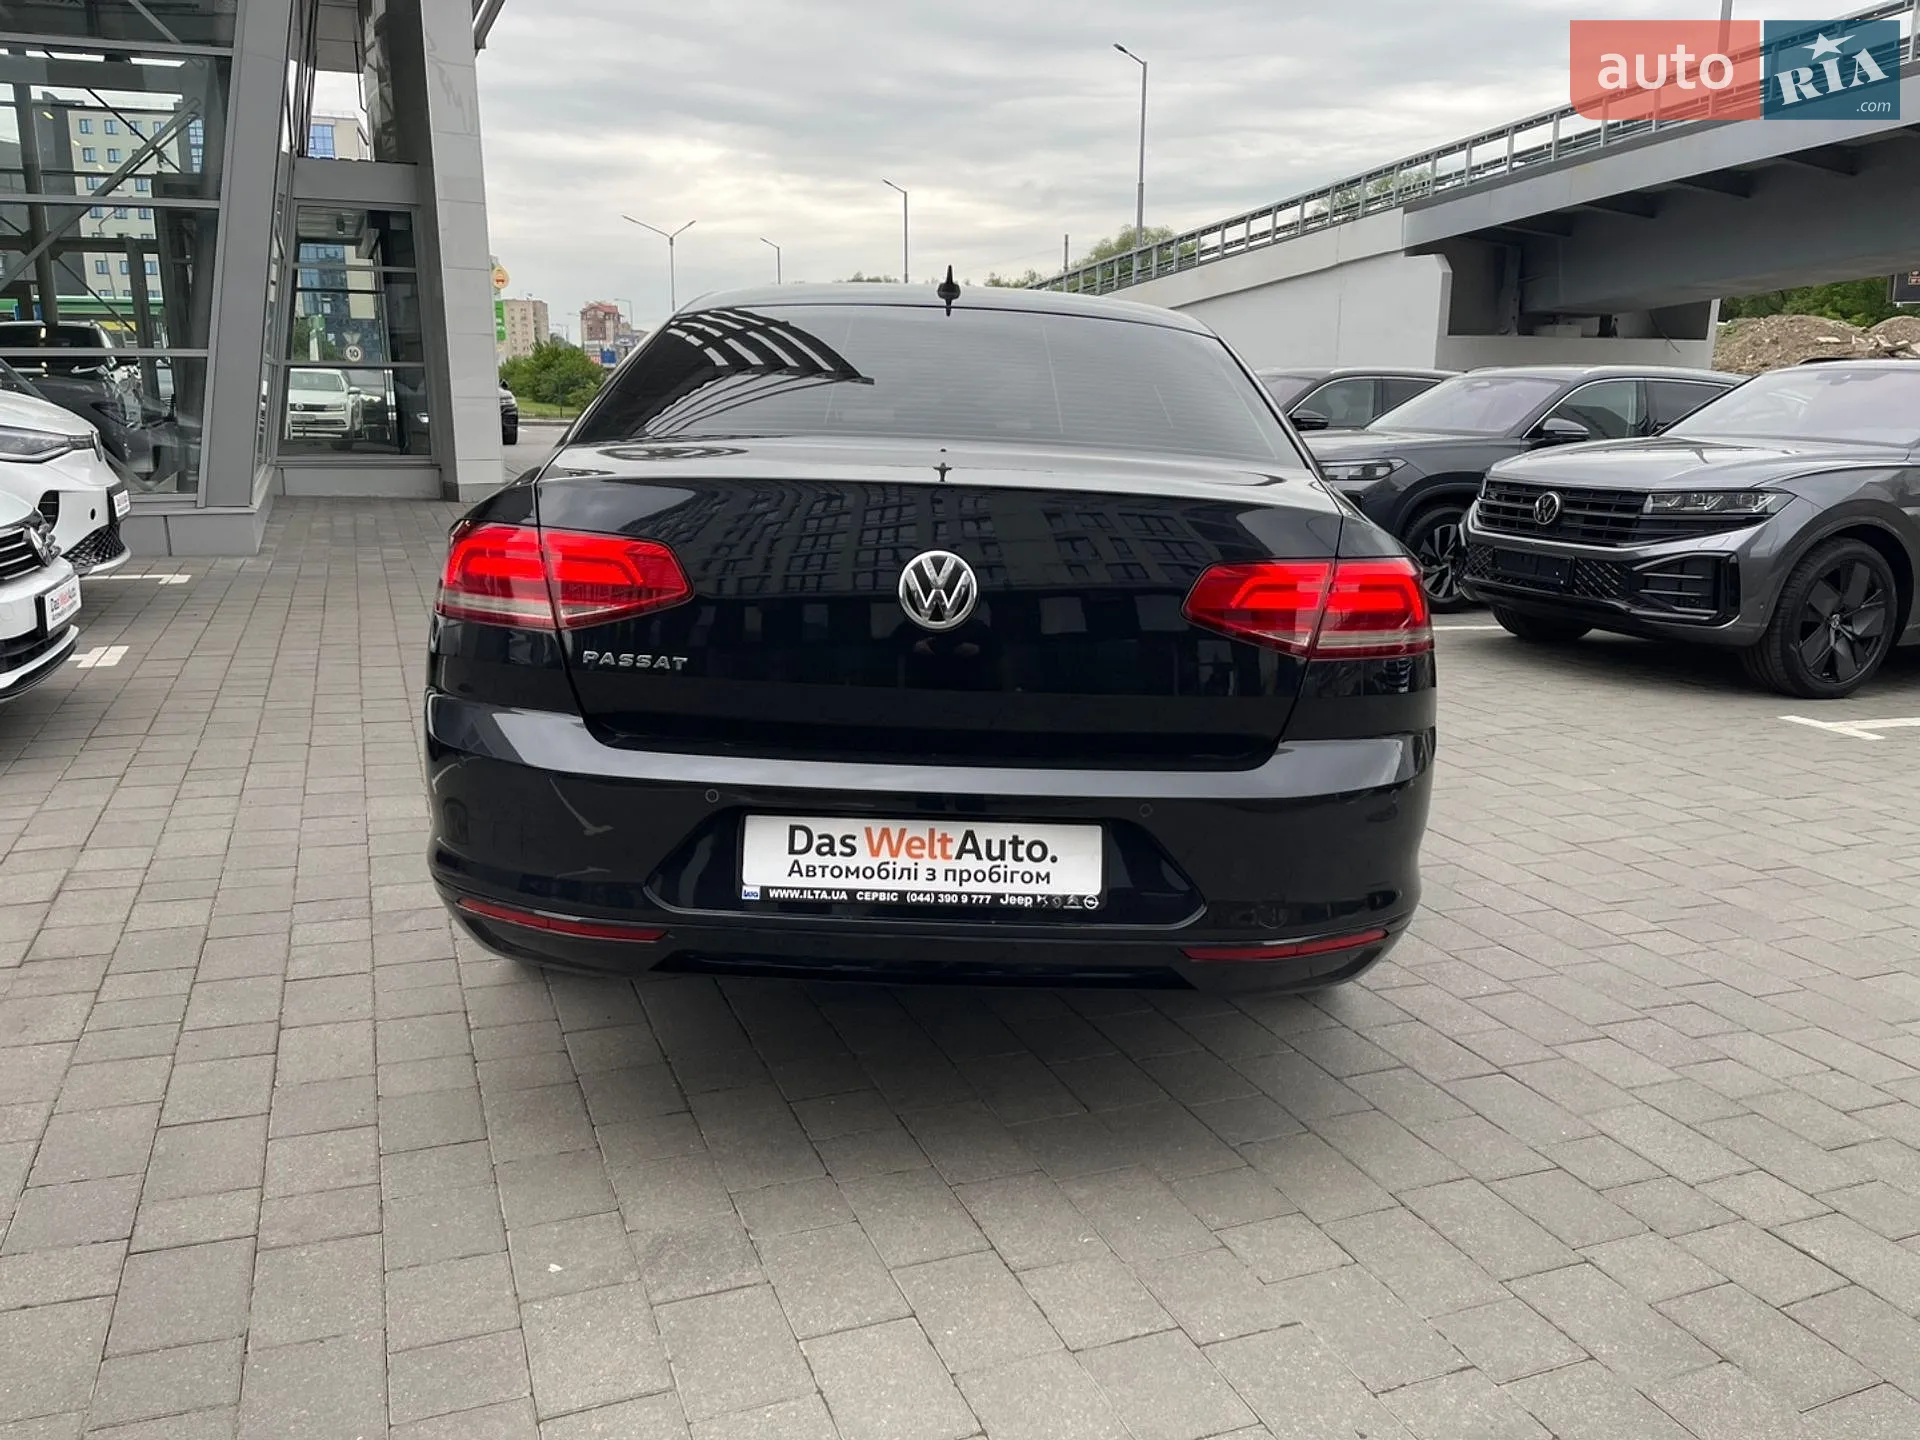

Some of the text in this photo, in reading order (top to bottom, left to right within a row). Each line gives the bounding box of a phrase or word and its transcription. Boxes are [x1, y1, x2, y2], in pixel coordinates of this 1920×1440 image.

[582, 650, 689, 671] PASSAT
[787, 823, 1059, 864] Das WeltAuto.
[787, 858, 1051, 887] Автомобілі з пробігом
[768, 888, 849, 901] WWW.ILTA.UA
[855, 890, 899, 903] СЕРВІС
[906, 892, 935, 904] (044)
[937, 893, 959, 905] 390
[960, 893, 969, 904] 9
[970, 894, 992, 905] 777
[999, 893, 1034, 908] Jeep
